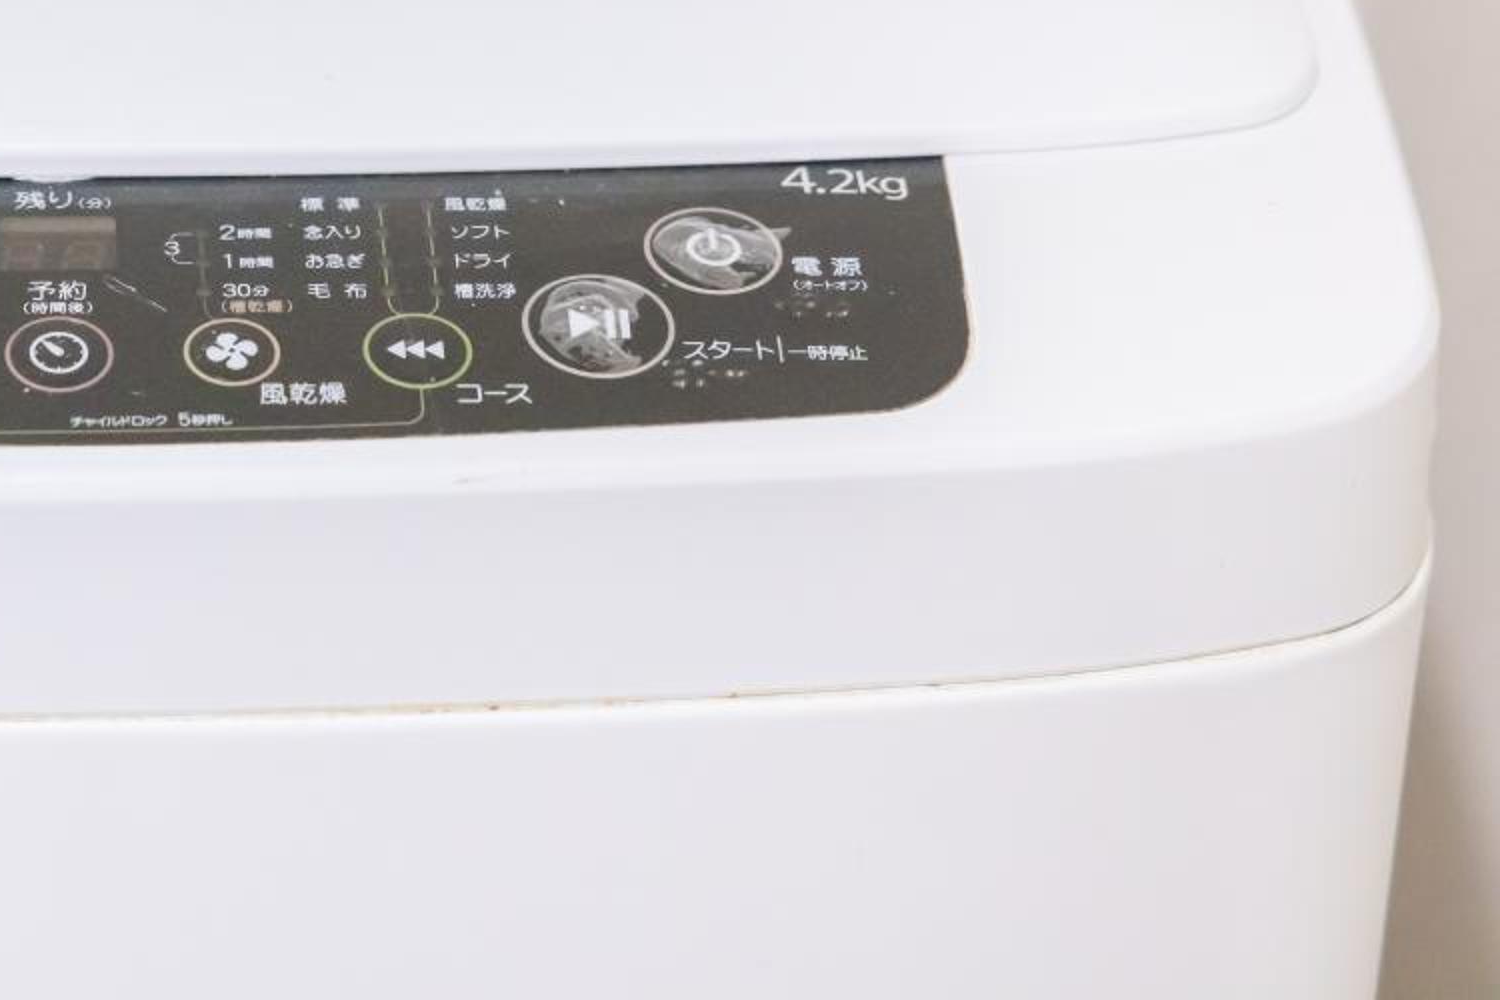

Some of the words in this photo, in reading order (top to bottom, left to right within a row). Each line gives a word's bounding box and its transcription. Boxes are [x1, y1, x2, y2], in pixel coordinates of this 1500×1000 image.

[781, 166, 909, 200] 4.2kg
[303, 224, 361, 240] 念入り
[451, 225, 510, 239] ソフト
[304, 253, 366, 269] お急ぎ
[454, 253, 511, 269] ドライ
[791, 256, 863, 277] 電源
[27, 280, 87, 301] 予約
[222, 283, 270, 298] 30分
[260, 382, 347, 405] 風乾燥
[455, 383, 533, 404] コース
